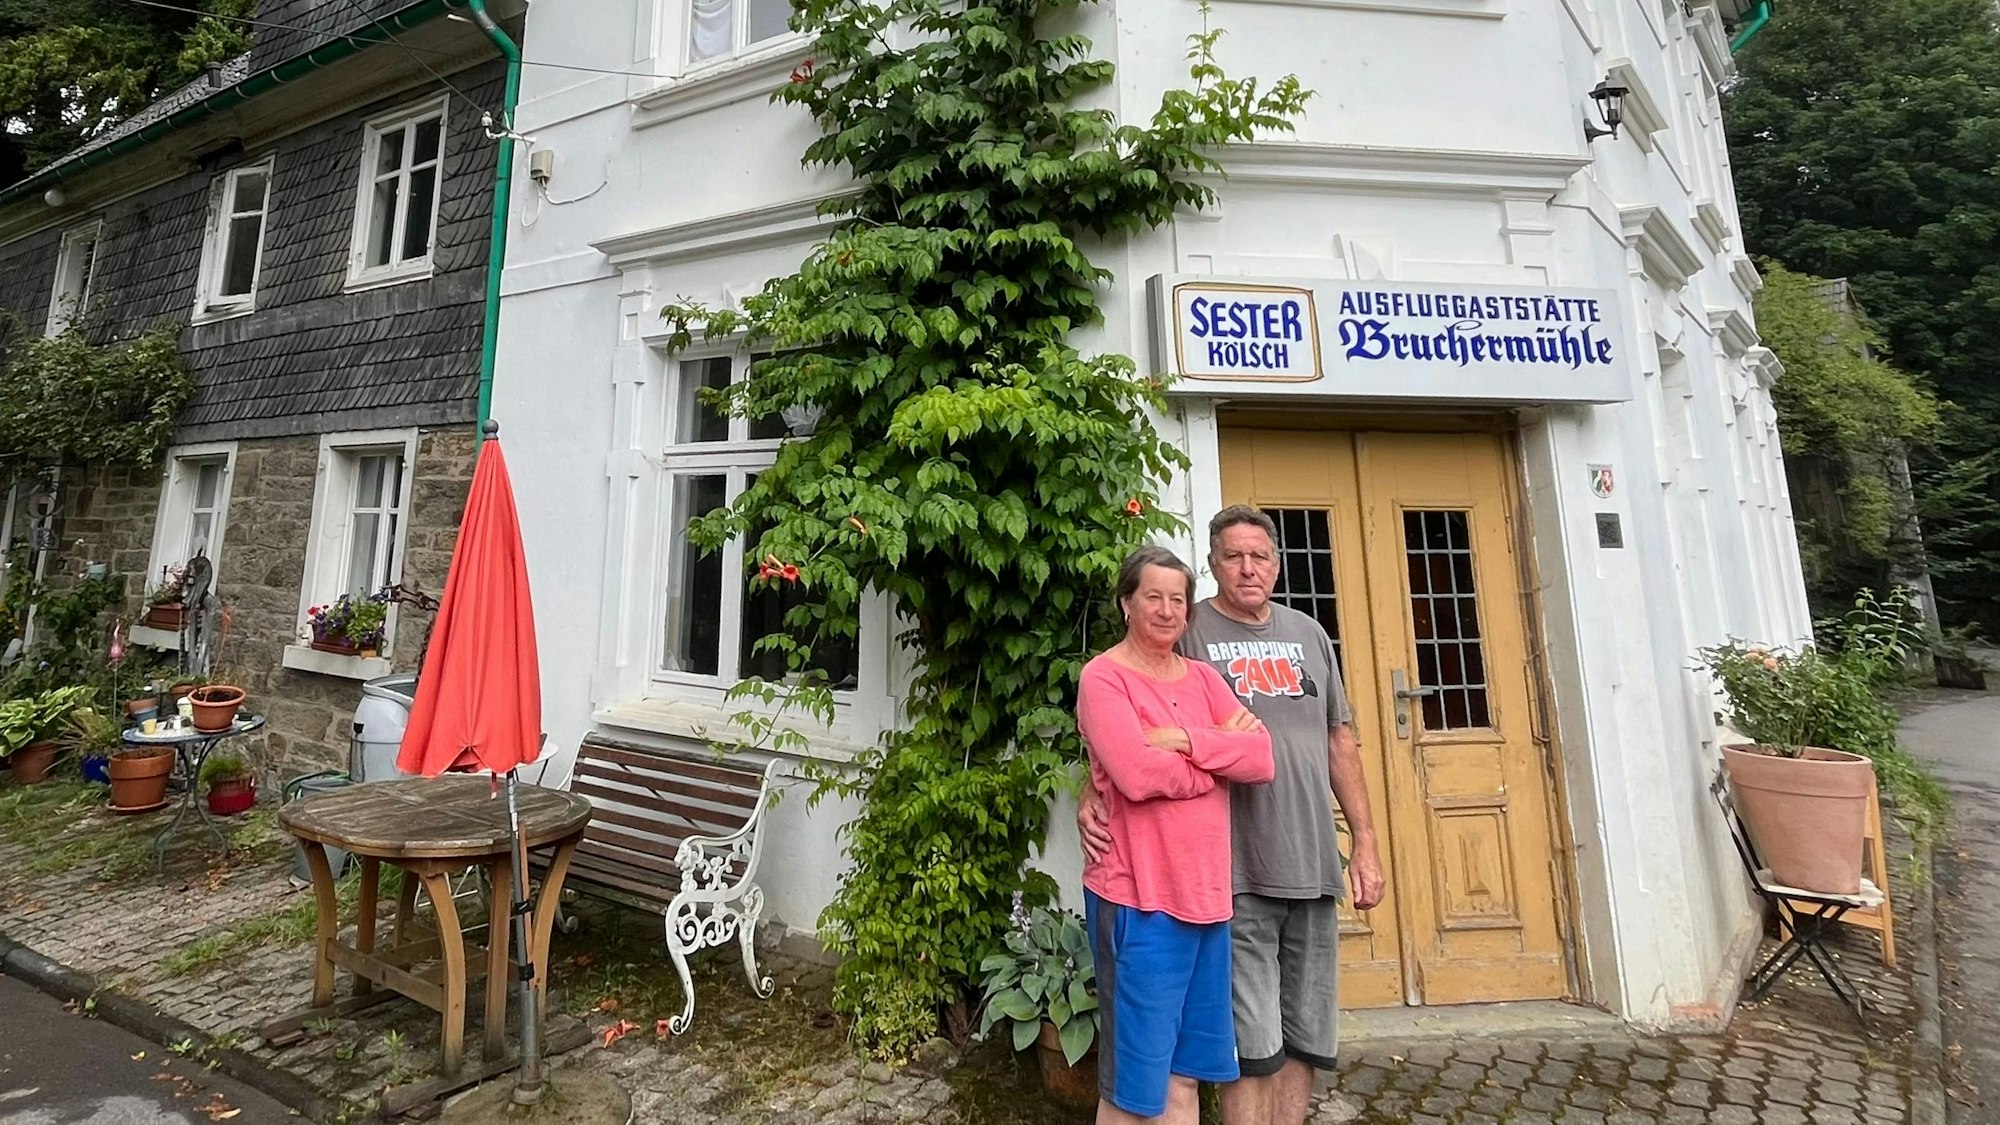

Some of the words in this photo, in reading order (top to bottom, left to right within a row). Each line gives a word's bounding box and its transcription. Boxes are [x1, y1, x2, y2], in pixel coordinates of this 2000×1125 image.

[1189, 296, 1303, 342] SESTER
[1338, 291, 1601, 323] AUSFLUGGASTSTÄTTE
[1208, 341, 1289, 369] KÖLSCH
[1339, 318, 1613, 371] Bruchermühle
[1206, 641, 1305, 661] BRENNPUNKT
